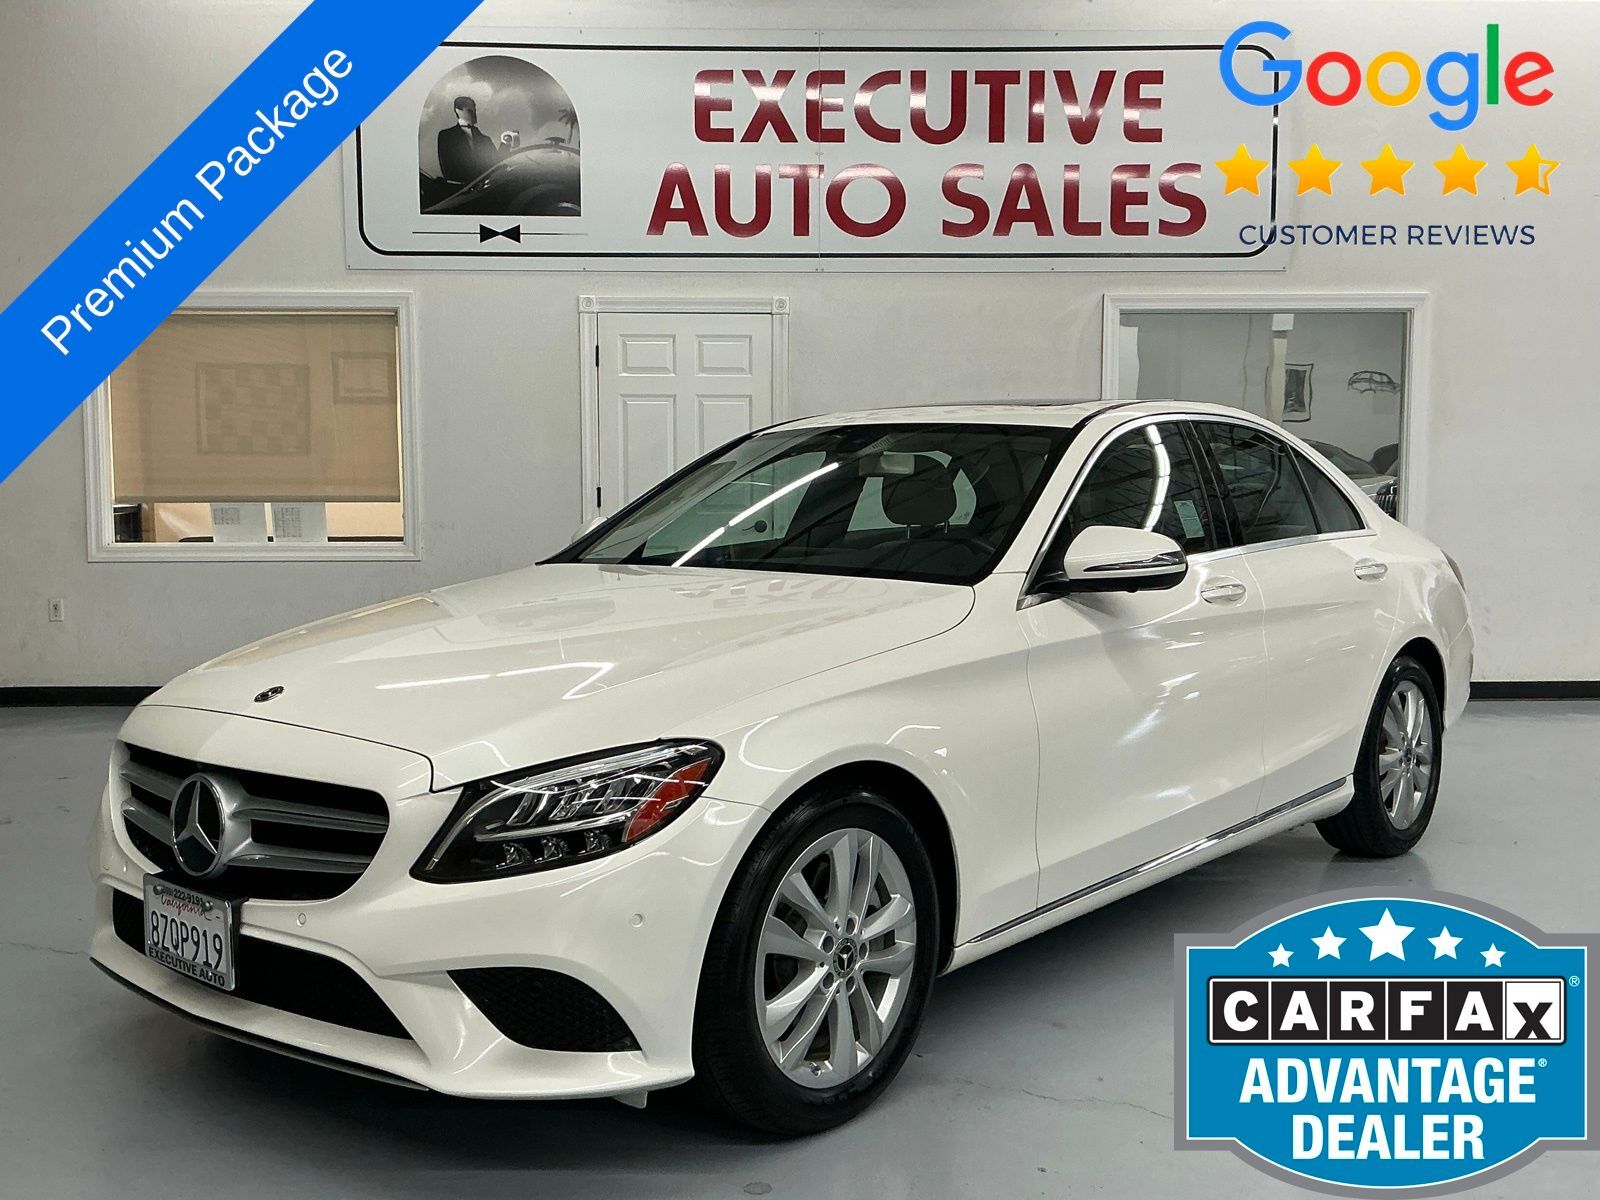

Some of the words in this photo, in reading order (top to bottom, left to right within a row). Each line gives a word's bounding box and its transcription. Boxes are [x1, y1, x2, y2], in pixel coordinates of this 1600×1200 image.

[693, 69, 1165, 145] EXECUTIVE
[646, 161, 907, 238] AUTO
[941, 162, 1208, 238] SALES
[149, 947, 198, 978] EXECUTIVE
[199, 968, 226, 987] AUTO
[150, 910, 223, 970] 8ZQP919
